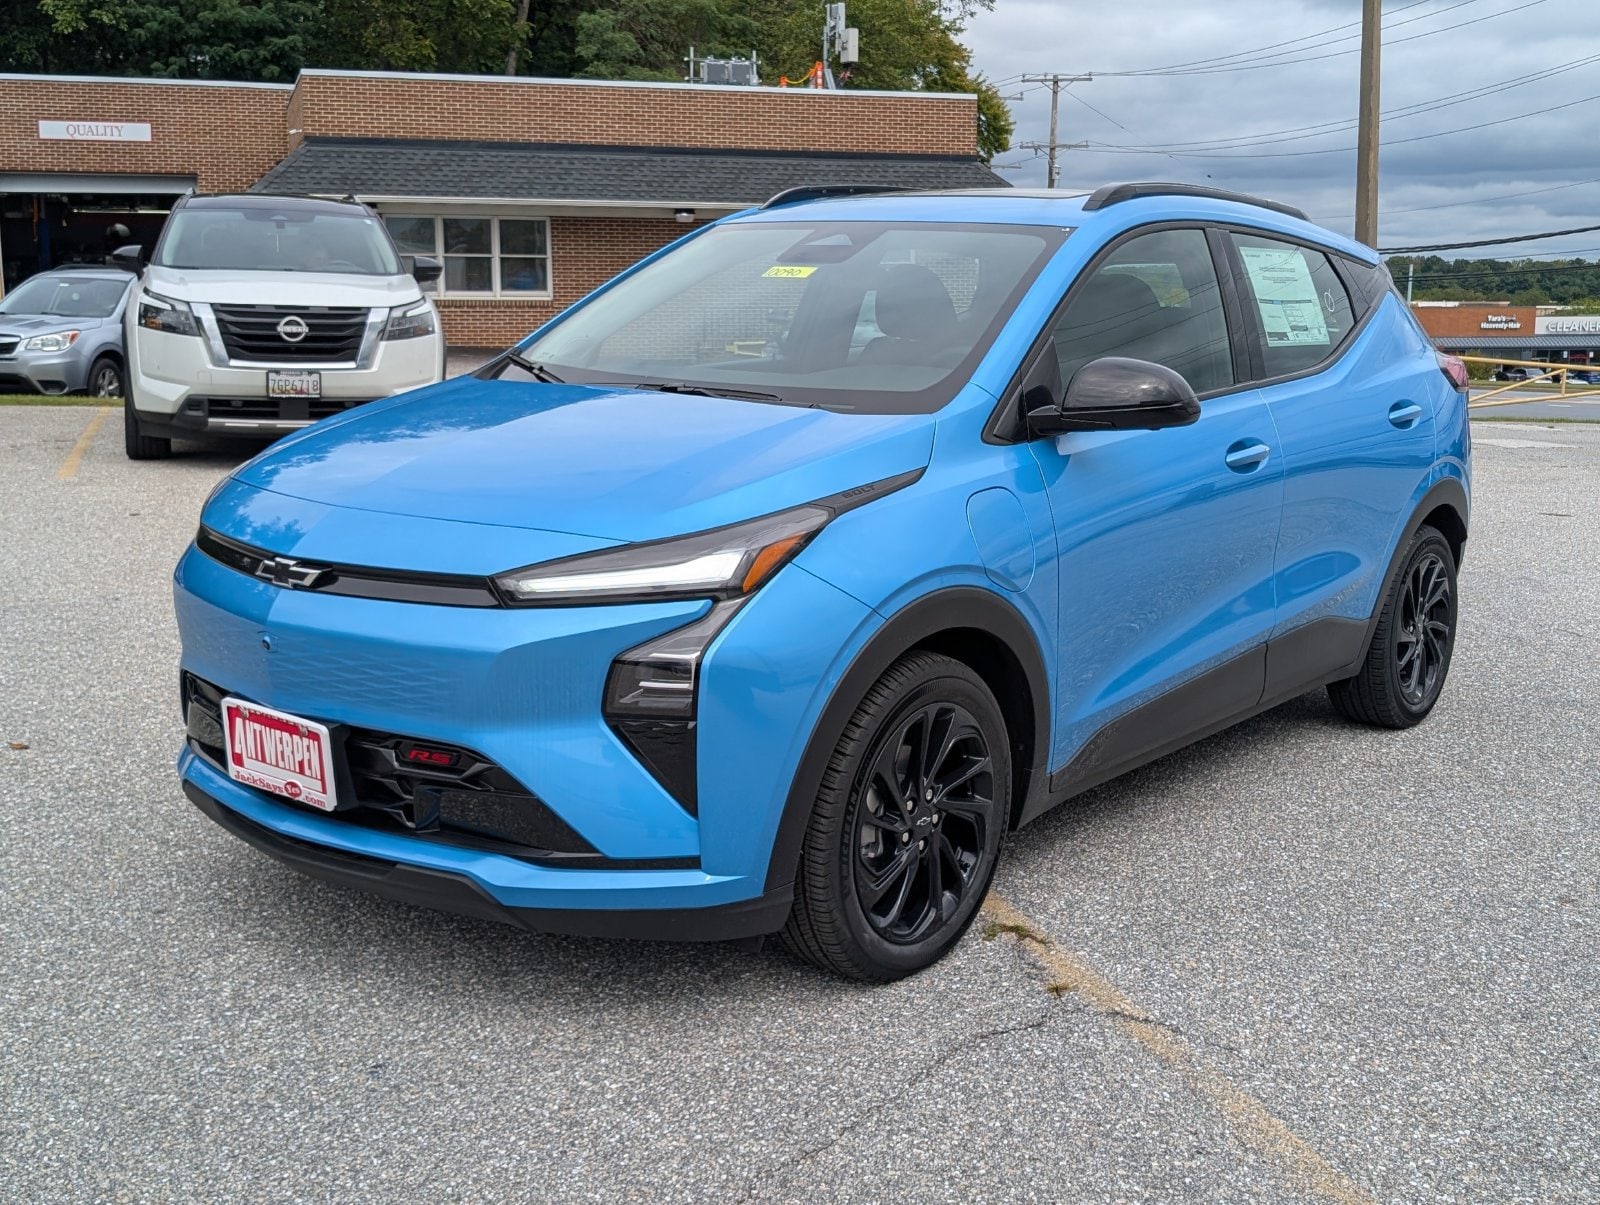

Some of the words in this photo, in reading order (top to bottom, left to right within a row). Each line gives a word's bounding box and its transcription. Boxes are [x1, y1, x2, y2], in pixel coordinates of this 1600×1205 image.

[67, 124, 123, 138] QUALITY
[270, 379, 319, 392] 7GP6718
[842, 485, 877, 499] BOLT
[234, 717, 321, 779] ANTWERPEN
[409, 749, 452, 764] RS
